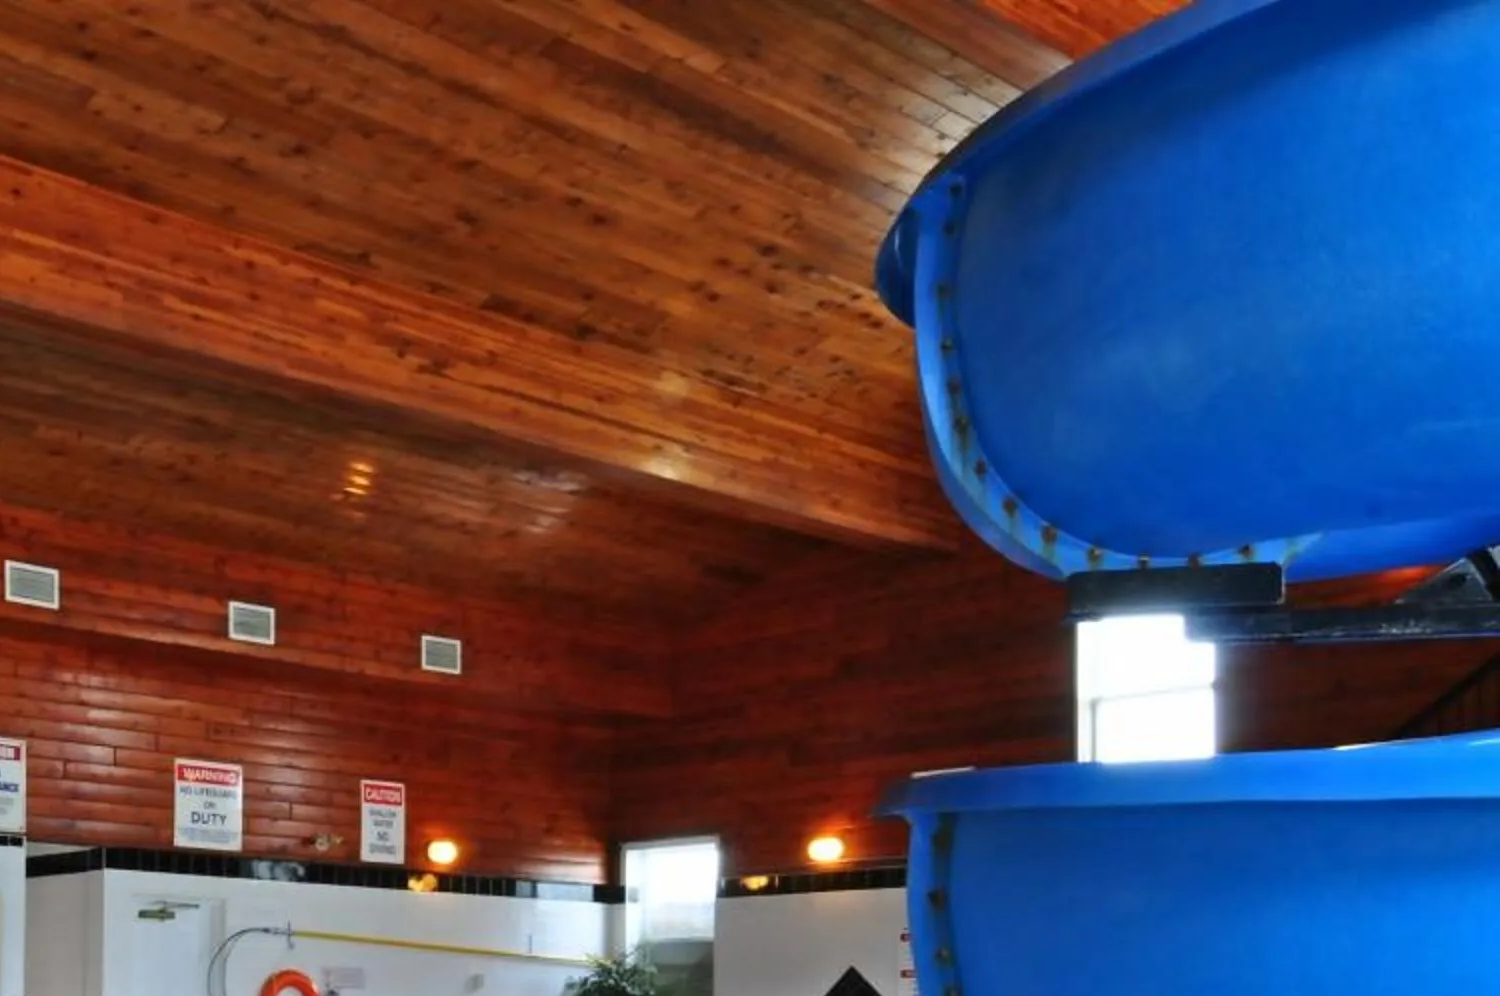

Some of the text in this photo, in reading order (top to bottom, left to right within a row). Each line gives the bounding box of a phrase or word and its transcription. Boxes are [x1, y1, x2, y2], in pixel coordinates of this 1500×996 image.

[182, 767, 237, 784] WARNING
[366, 786, 401, 803] CAUTION
[190, 811, 227, 825] DUTY
